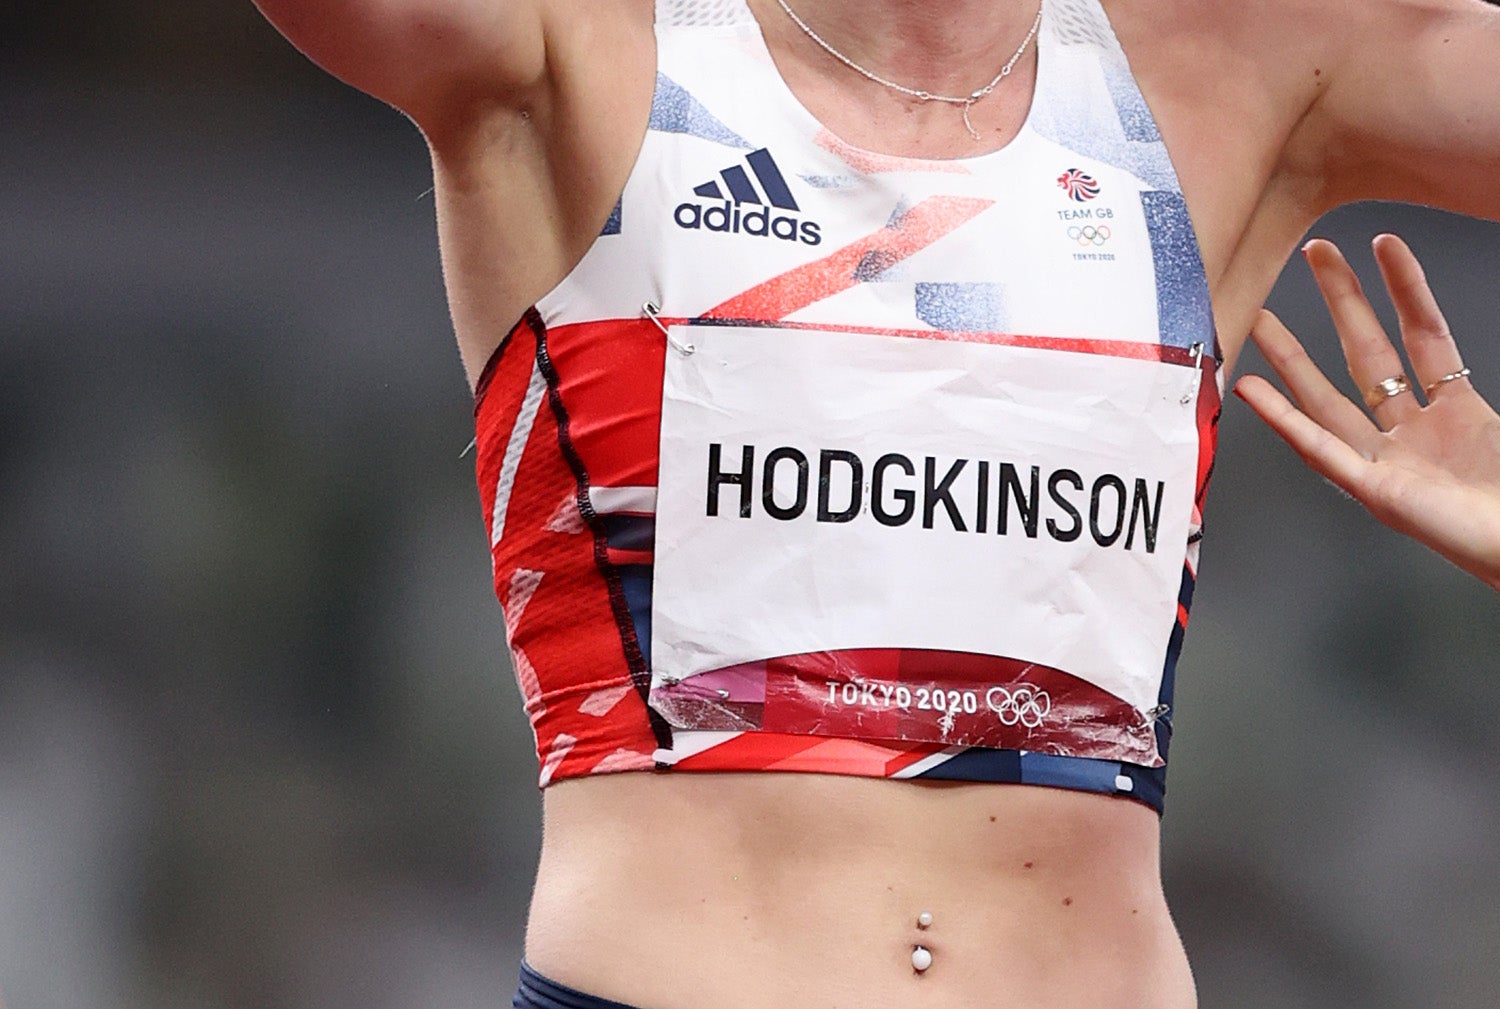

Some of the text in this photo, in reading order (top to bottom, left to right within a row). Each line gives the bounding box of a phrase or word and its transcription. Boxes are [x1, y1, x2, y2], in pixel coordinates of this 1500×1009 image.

[674, 199, 822, 246] adidas
[1057, 207, 1114, 220] TEAM GB
[1072, 253, 1097, 261] TOKYO
[705, 442, 1165, 554] HODGKINSON
[825, 681, 977, 714] TOKYO 2020
